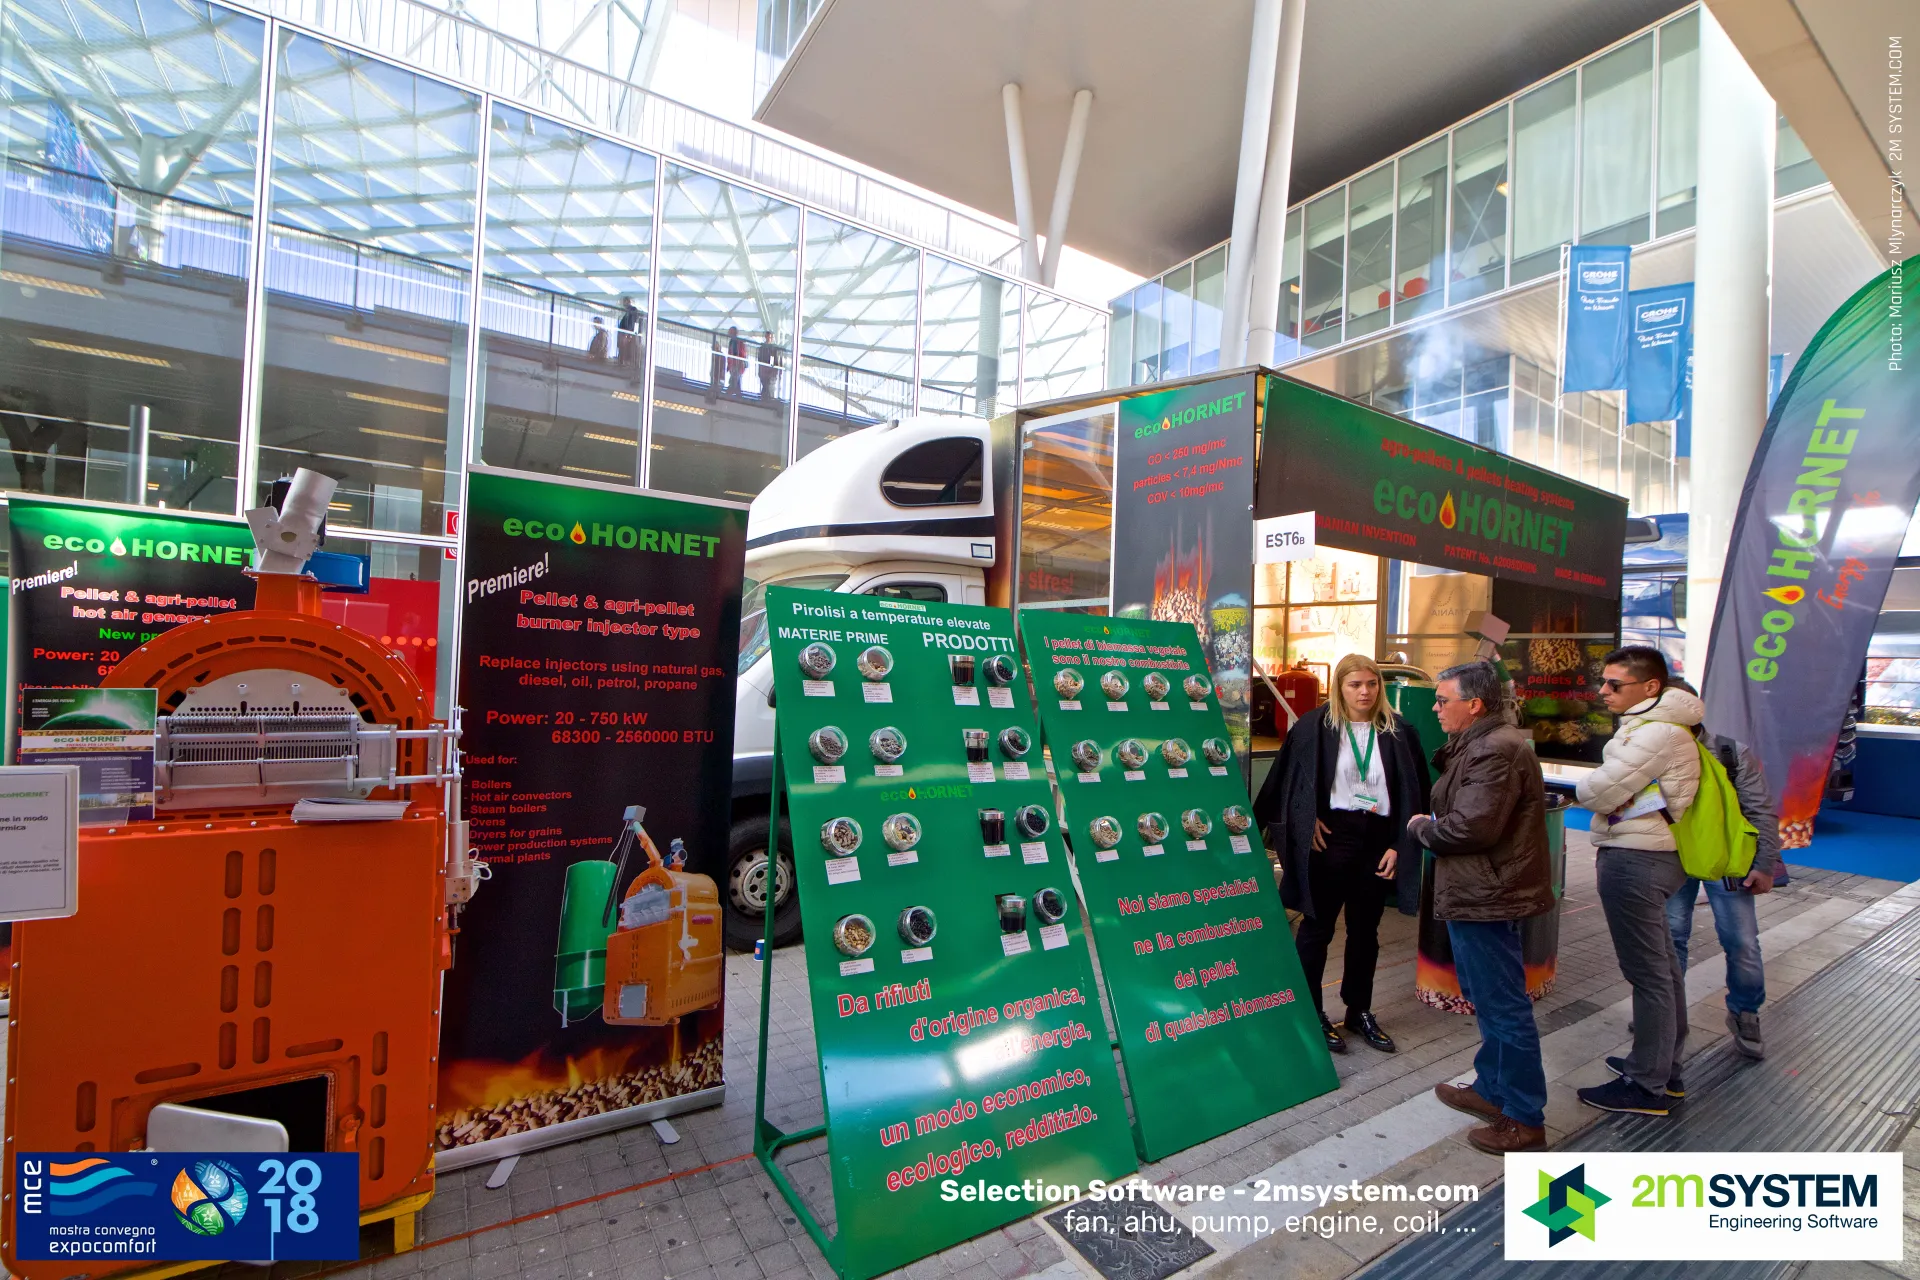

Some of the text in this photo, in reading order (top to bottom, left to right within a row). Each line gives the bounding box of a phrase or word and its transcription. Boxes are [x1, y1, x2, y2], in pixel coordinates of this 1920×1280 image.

[1582, 270, 1618, 279] GROHE
[1641, 305, 1679, 319] GROHE
[1134, 391, 1248, 440] eco HORNET
[1147, 436, 1228, 466] CO < 250 mg/mc
[1133, 455, 1244, 491] particles < 7,4 mg/Nmc
[1381, 437, 1575, 511] agro-pellets & pellets heating systems
[1147, 480, 1225, 505] COV < 10mg/mc
[1765, 398, 1868, 580] HORNET
[1373, 478, 1574, 558] eco HORNET
[43, 534, 105, 554] eco
[503, 517, 721, 558] eco HORNET
[1265, 531, 1305, 548] EST6B
[1361, 524, 1417, 547] INVENTION
[1444, 544, 1477, 561] PATENT
[12, 560, 79, 595] Premiere!
[468, 551, 549, 604] Premiere!
[1028, 566, 1074, 594] stres!
[60, 586, 237, 609] Pellet & agri-pellet
[520, 590, 695, 617] Pellet & agri-pellet
[72, 606, 138, 621] hot air
[792, 602, 991, 631] Pirolisi a temperature elevate
[99, 628, 136, 640] New
[516, 613, 700, 641] burner injector type
[778, 627, 1015, 652] MATERIE PRIME PRODOTTI
[1044, 635, 1187, 657] I pellet di biomassa vegetale
[1746, 609, 1796, 682] eco
[33, 648, 120, 661] Power: 20
[1052, 654, 1191, 670] sono il nostro combustibile
[479, 655, 726, 678] Replace injectors using natural gas,
[519, 673, 698, 692] diesel, oil, petrol, propane
[1527, 674, 1586, 686] pellets &
[486, 710, 648, 725] Power: 20 750 kW
[551, 730, 714, 744] 68300 2560000 BTU
[466, 755, 518, 765] Used for:
[471, 779, 512, 790] Boilers
[471, 789, 573, 802] Hot air convectors
[881, 784, 974, 801] eco HORNET
[470, 803, 547, 815] Steam boilers
[469, 817, 506, 827] Ovens
[469, 826, 563, 840] Dryers for grains
[469, 835, 613, 852] Power production systems
[517, 852, 551, 864] plants
[1118, 877, 1259, 916] Noi siamo specialisti
[1133, 916, 1263, 955] ne lla combustione
[1174, 958, 1239, 989] dei pellet
[837, 978, 932, 1018] Da rifiuti
[910, 987, 1086, 1042] d'origine organica,
[1145, 988, 1295, 1042] di qualsiasi biomassa
[880, 1068, 1091, 1147] un modo economico,
[886, 1104, 1098, 1191] ecologico, redditizio.
